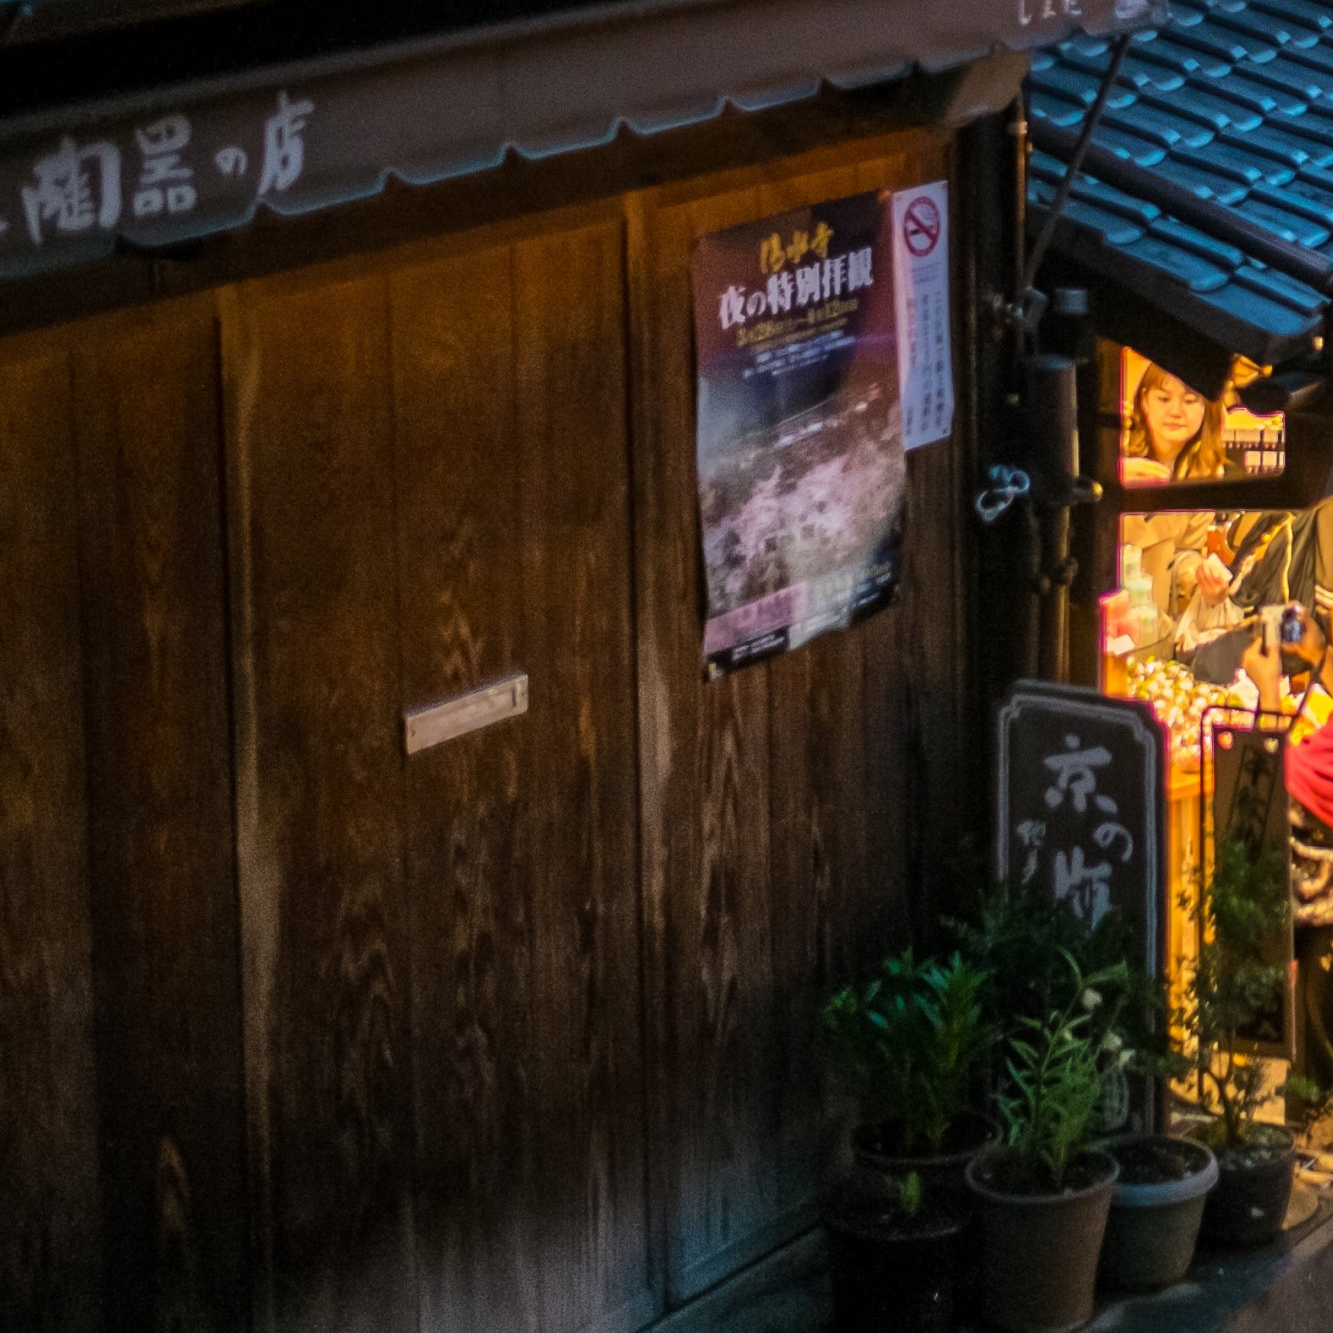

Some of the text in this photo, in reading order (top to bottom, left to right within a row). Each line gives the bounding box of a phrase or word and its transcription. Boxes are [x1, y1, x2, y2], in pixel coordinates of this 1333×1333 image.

[19, 90, 317, 248] 陶器の店
[718, 246, 875, 330] 夜の特別拝観
[759, 220, 835, 274] 清水寺
